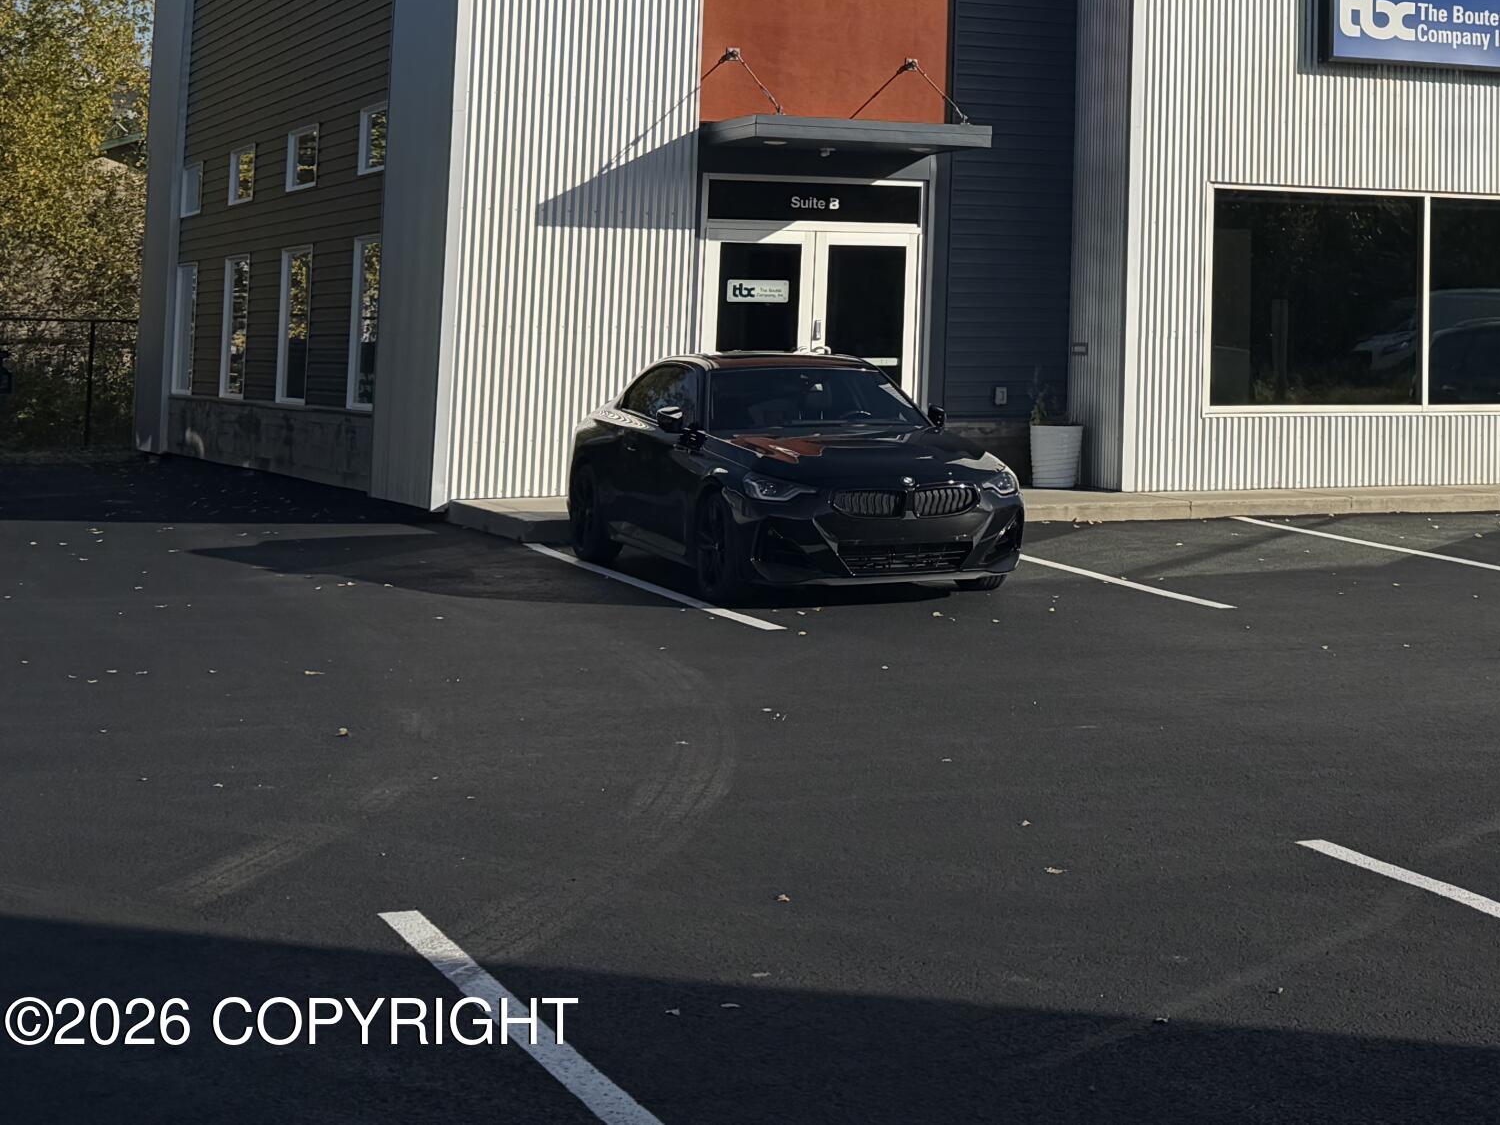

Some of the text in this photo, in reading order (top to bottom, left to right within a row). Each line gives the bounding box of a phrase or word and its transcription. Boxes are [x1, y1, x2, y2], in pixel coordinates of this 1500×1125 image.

[1417, 2, 1448, 23] The
[1417, 23, 1491, 51] Company
[790, 196, 826, 209] Suite
